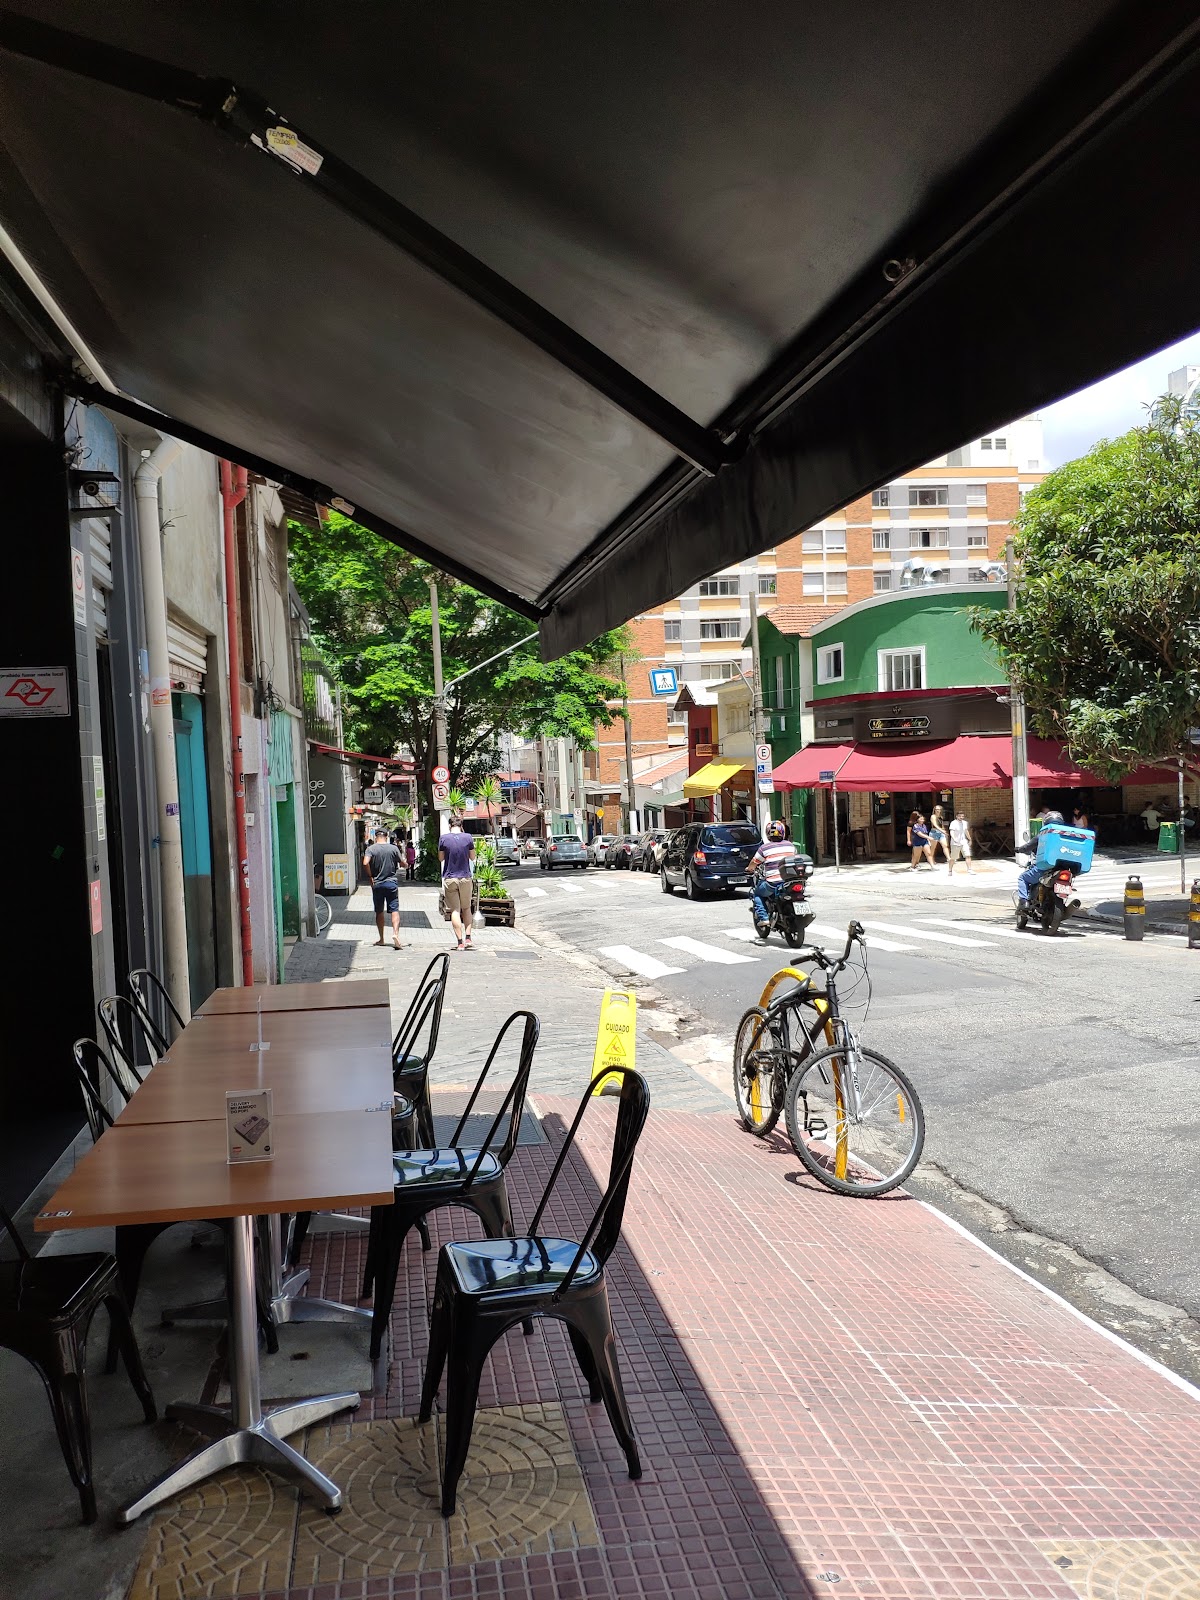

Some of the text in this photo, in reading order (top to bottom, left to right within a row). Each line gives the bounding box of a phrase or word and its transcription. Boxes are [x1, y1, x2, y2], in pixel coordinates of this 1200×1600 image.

[268, 129, 297, 140] TEMPRA
[435, 770, 446, 778] 40
[327, 869, 344, 885] 10
[605, 1023, 630, 1033] CUIDADO
